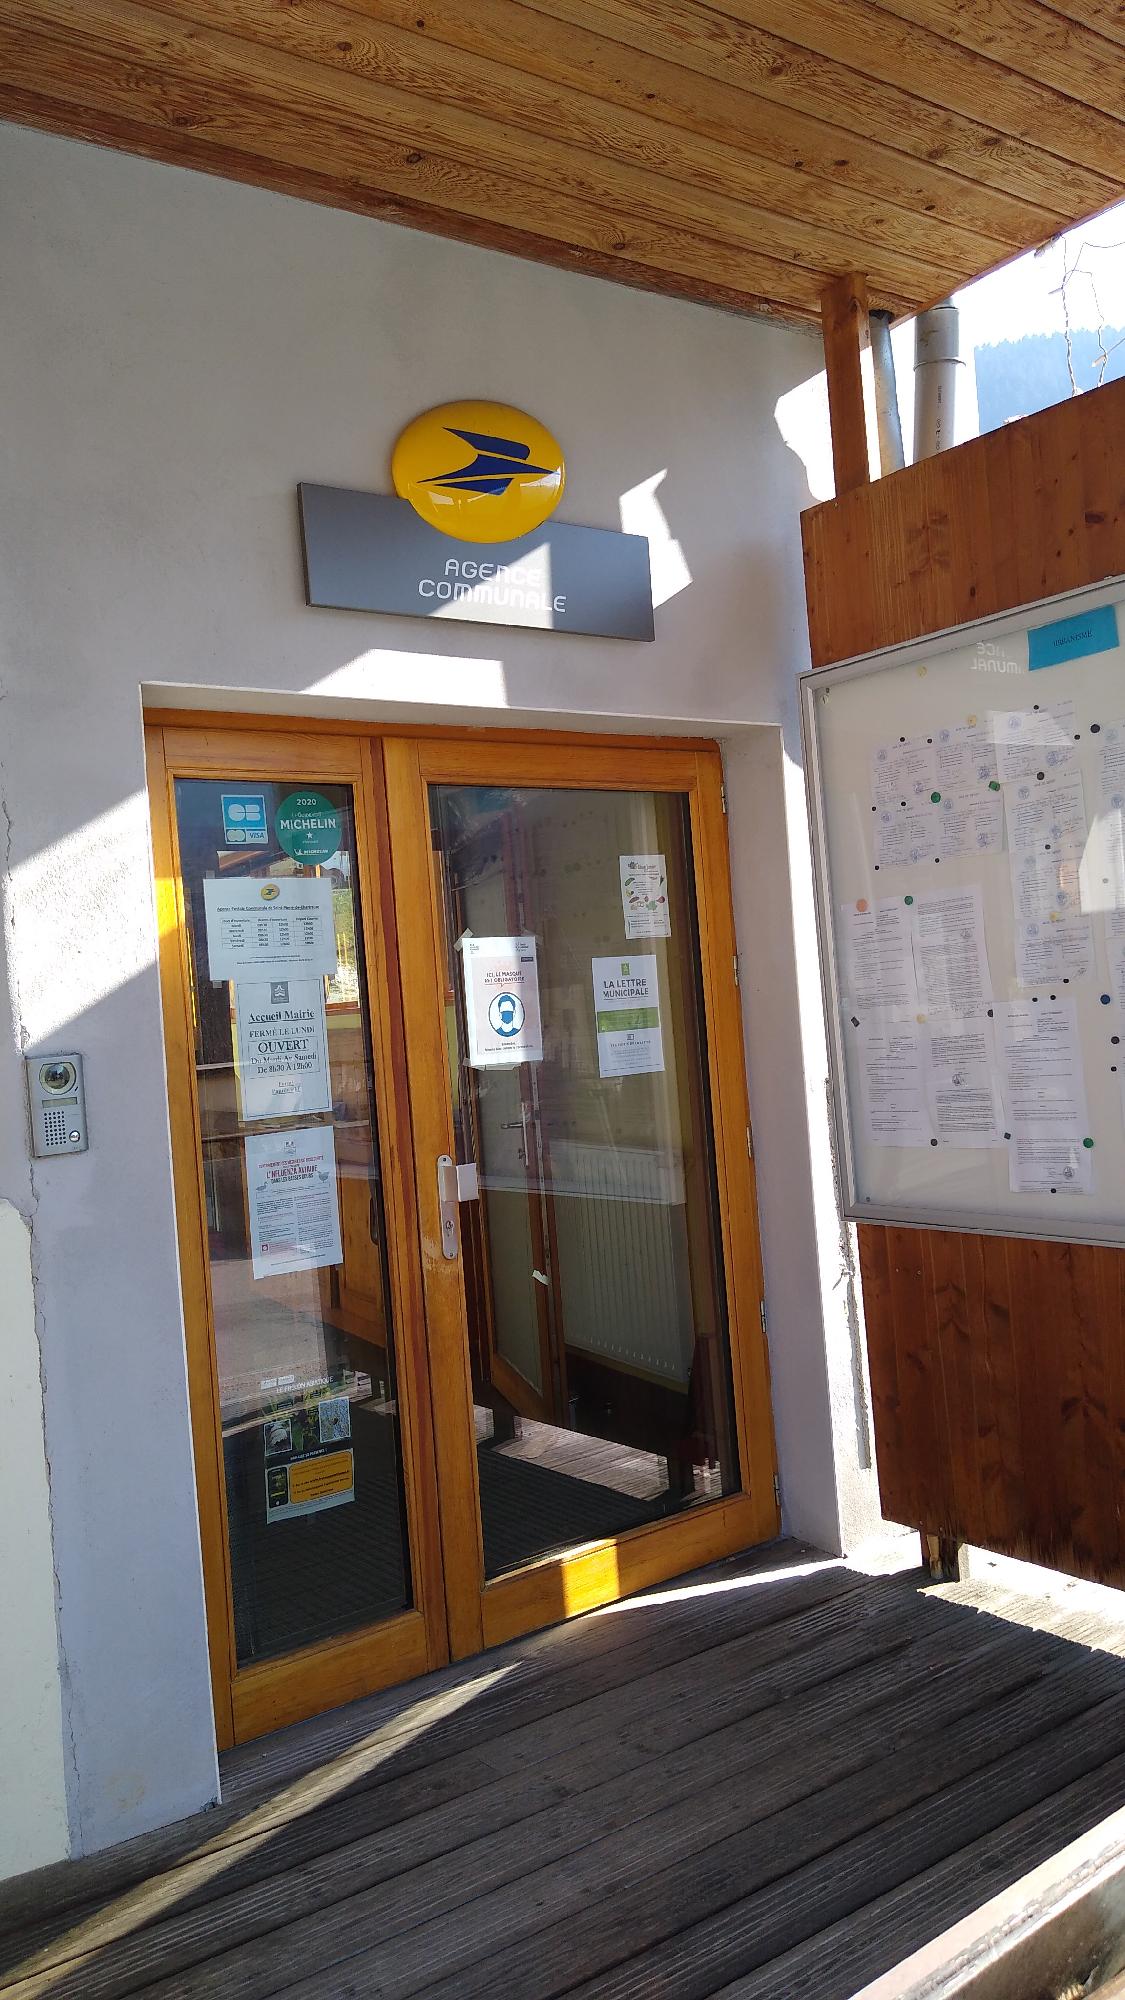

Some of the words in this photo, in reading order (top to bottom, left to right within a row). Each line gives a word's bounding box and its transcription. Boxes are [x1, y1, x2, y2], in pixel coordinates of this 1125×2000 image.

[444, 558, 545, 588] AGENCE
[418, 579, 567, 614] COMMUNALE
[1053, 628, 1094, 648] URBANISME
[296, 798, 317, 806] 2020
[280, 818, 337, 830] MICHELIN
[603, 980, 615, 989] LA
[616, 978, 647, 988] LETTRE
[603, 987, 649, 998] MUNICIPALE
[249, 1011, 282, 1022] Accueil
[284, 1009, 315, 1019] Mairie
[279, 1028, 290, 1036] LE
[291, 1026, 315, 1034] LUNDI
[258, 1038, 309, 1054] OUVERT
[251, 1057, 262, 1065] Du
[294, 1052, 317, 1061] Samedi
[257, 1066, 268, 1074] De
[269, 1064, 285, 1073] 8h30
[293, 1061, 313, 1070] 12h00
